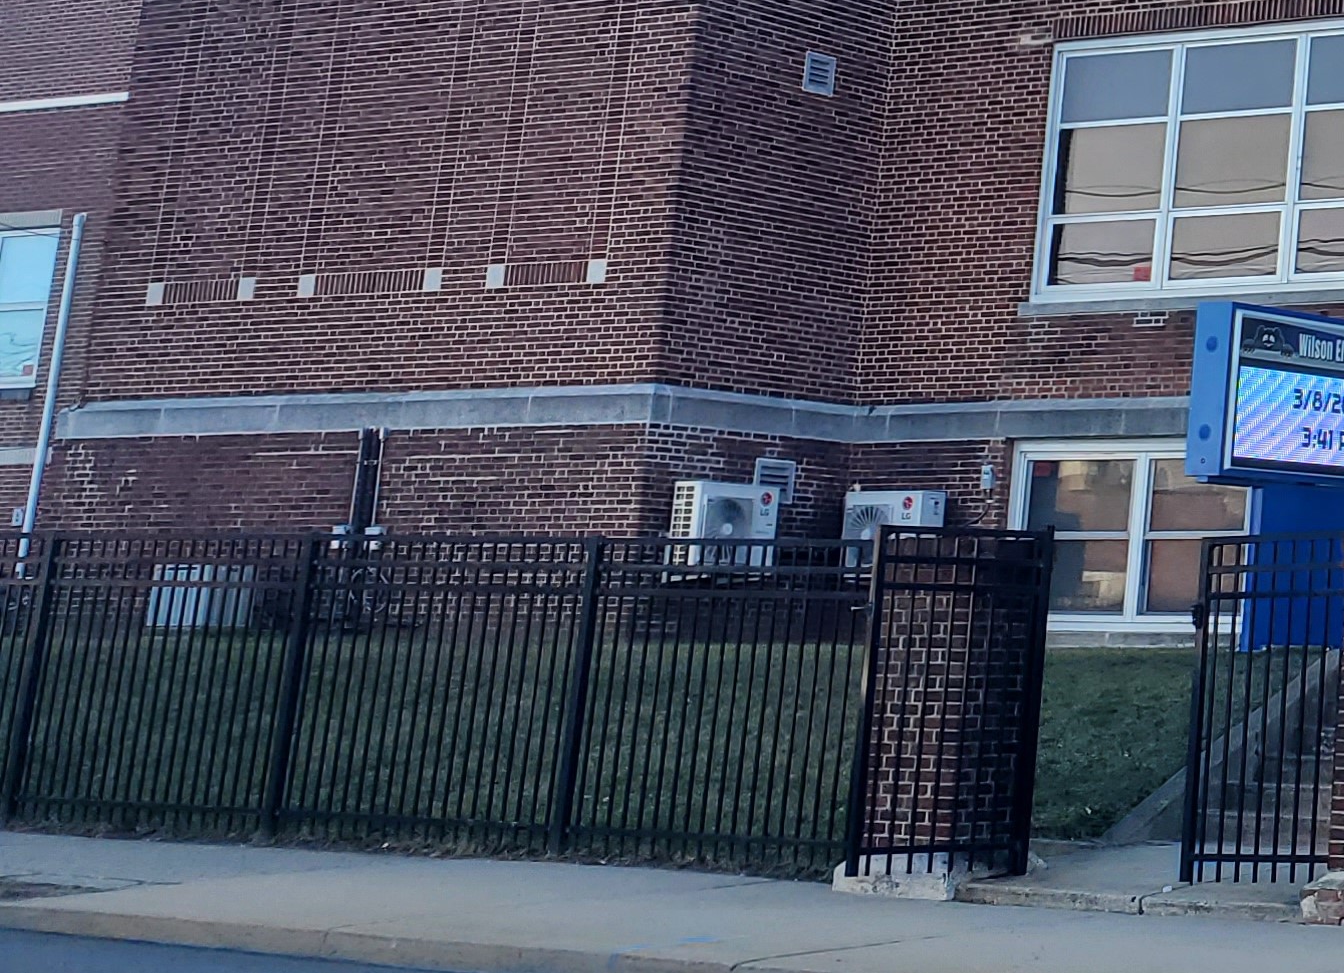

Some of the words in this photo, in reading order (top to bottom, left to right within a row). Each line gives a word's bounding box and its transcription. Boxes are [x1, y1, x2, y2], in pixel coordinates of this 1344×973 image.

[1299, 333, 1333, 361] Wilson
[1301, 426, 1333, 450] 3:41
[760, 508, 770, 516] LG
[901, 512, 911, 520] LG
